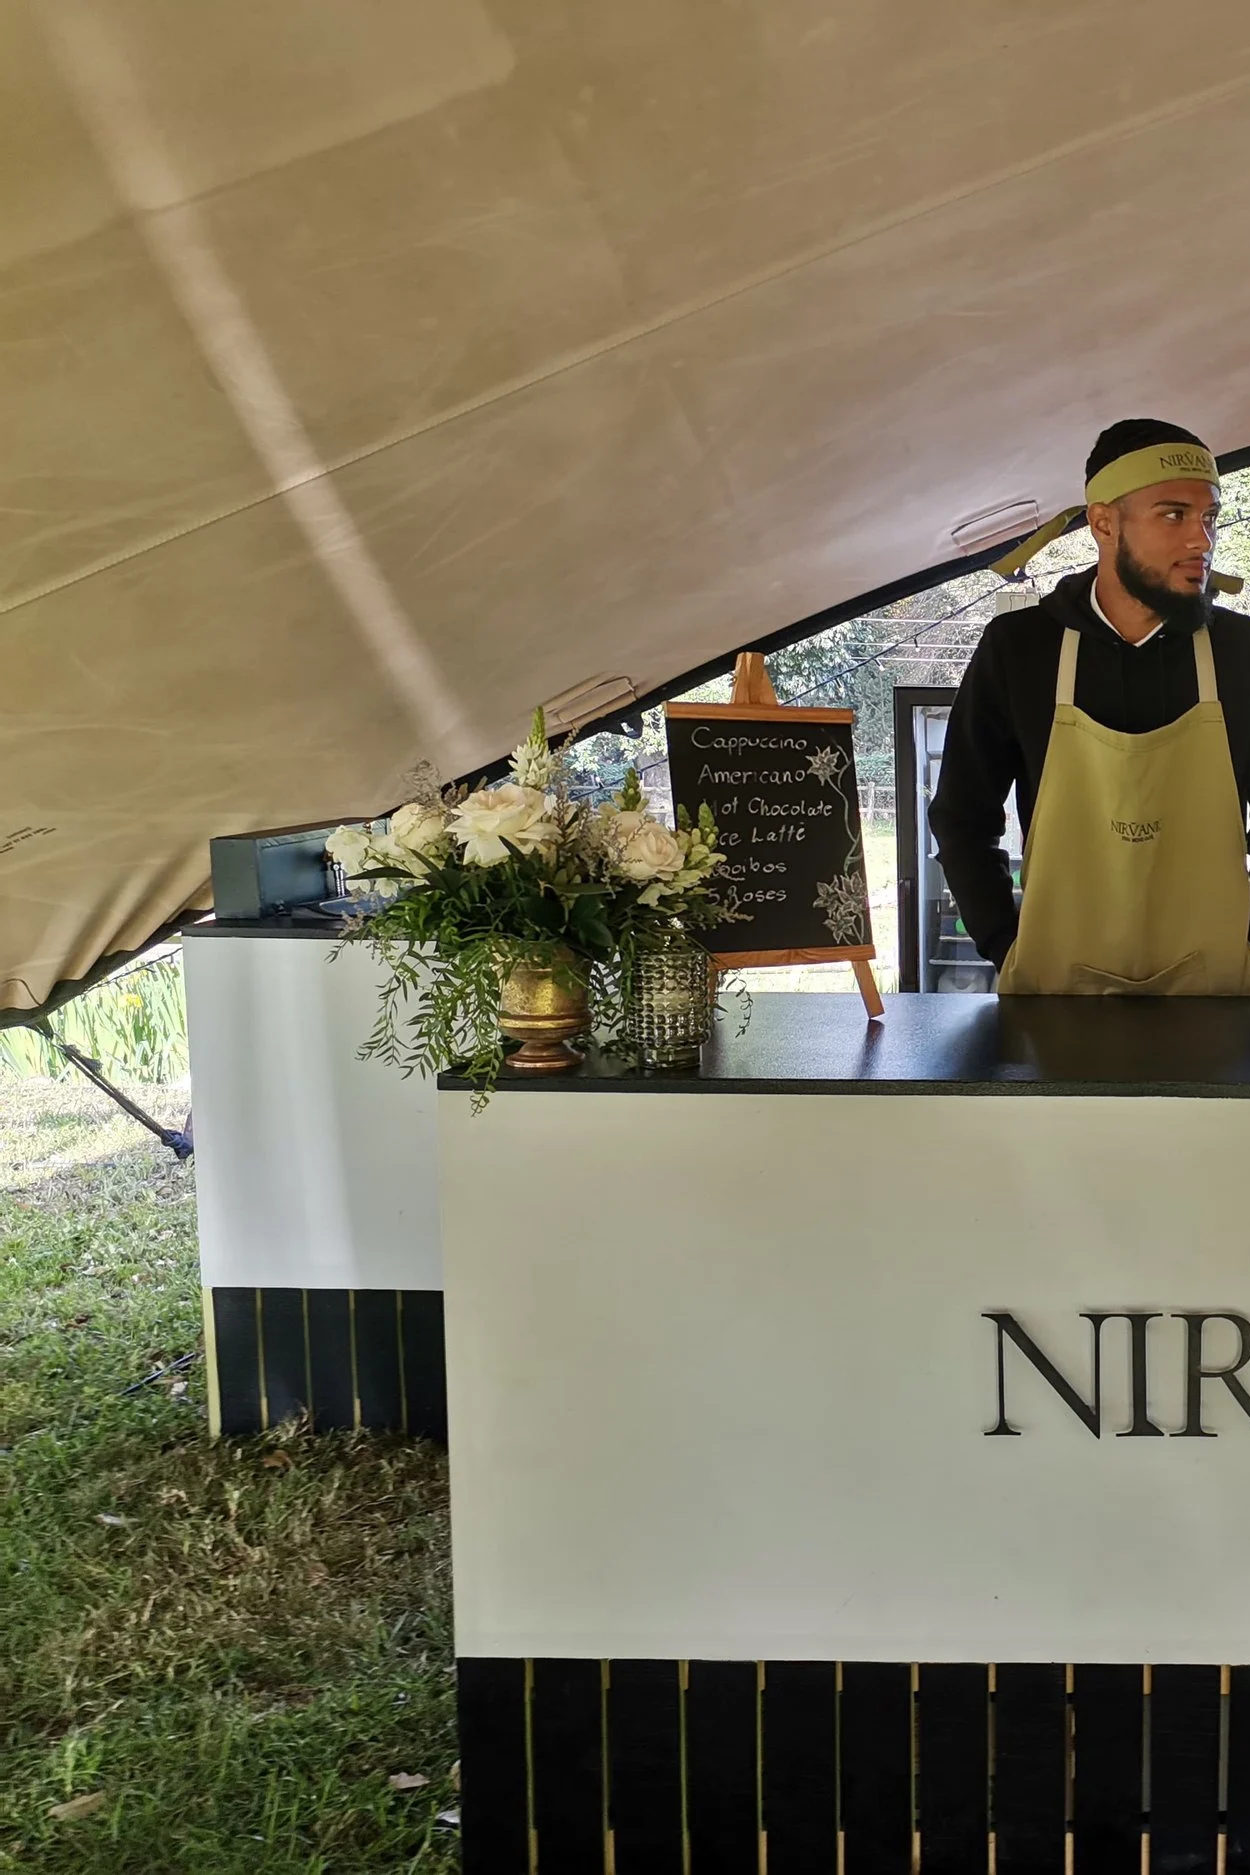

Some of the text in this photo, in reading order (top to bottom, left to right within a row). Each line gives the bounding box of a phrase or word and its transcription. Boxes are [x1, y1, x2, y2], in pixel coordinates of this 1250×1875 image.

[691, 726, 807, 756] Cappuccino
[697, 764, 806, 785] Americano
[748, 797, 833, 816] Chocolate
[719, 831, 742, 846] ce
[728, 886, 787, 913] Roses
